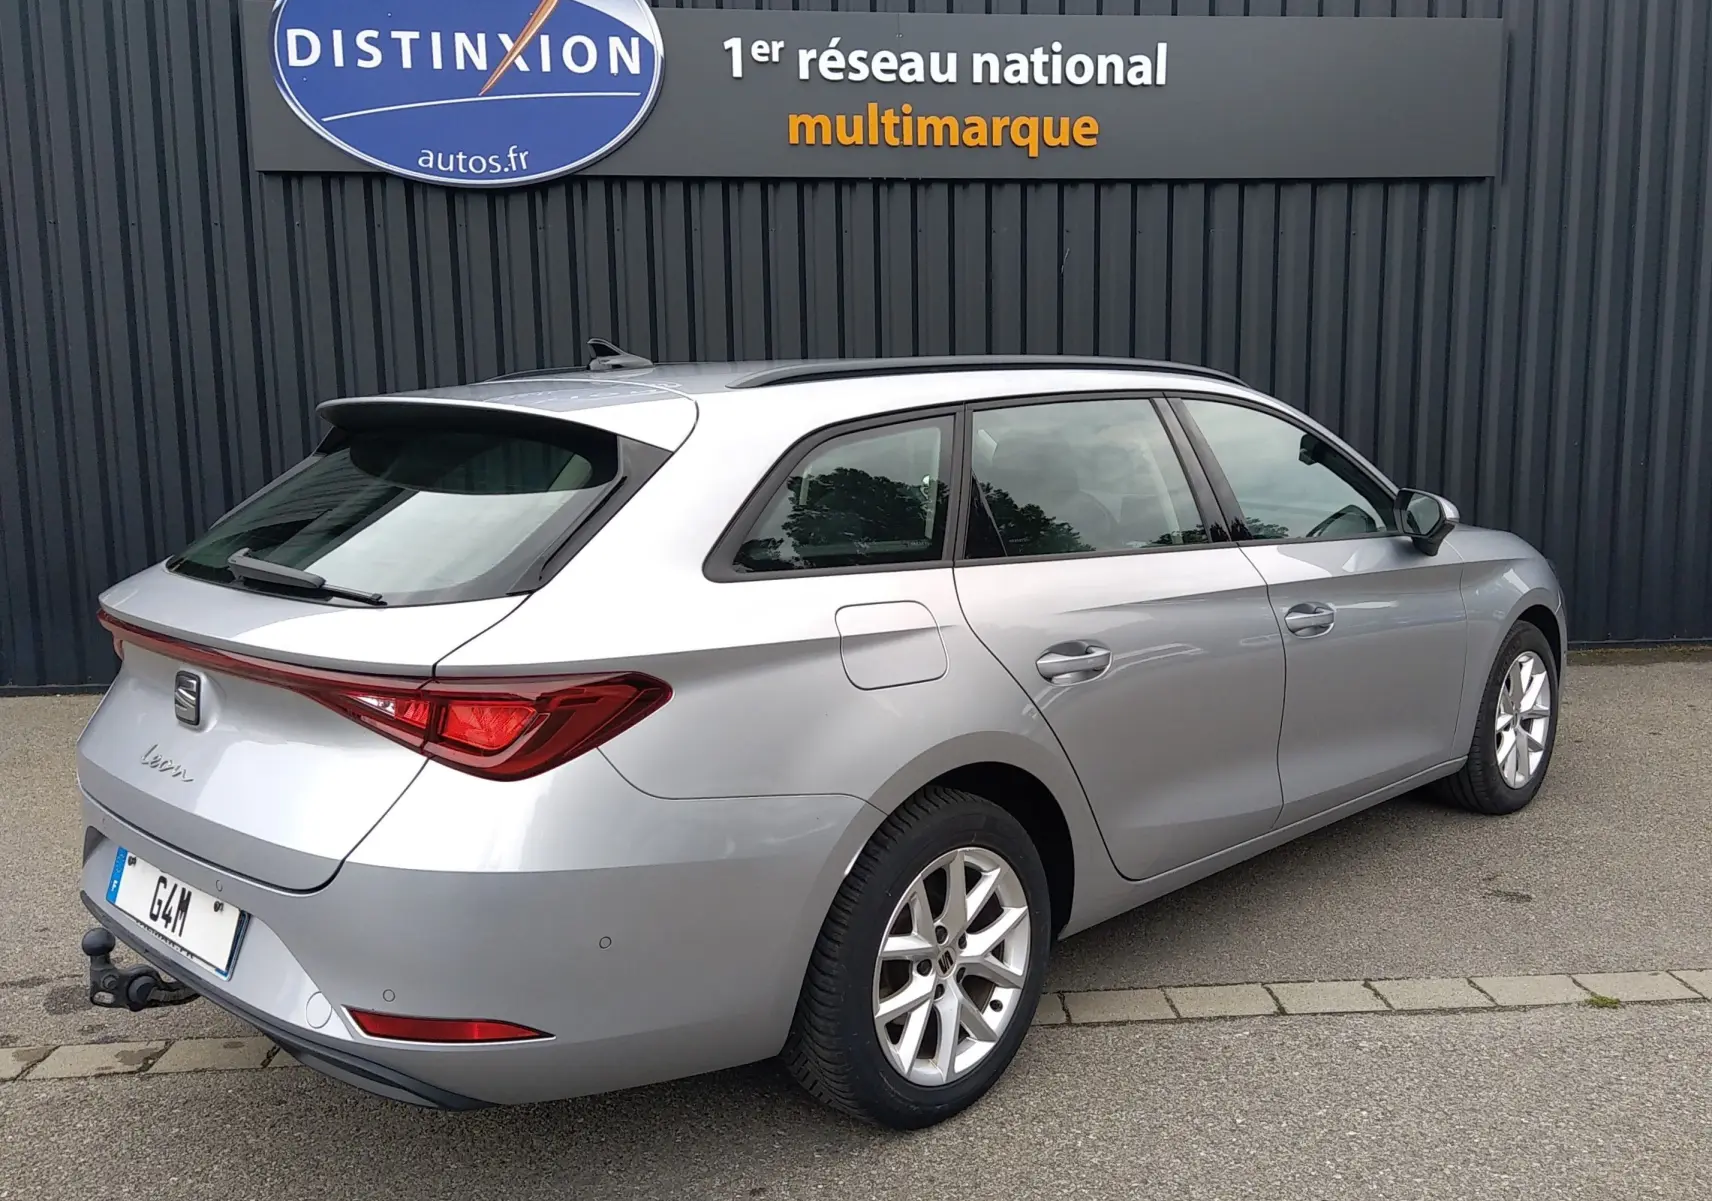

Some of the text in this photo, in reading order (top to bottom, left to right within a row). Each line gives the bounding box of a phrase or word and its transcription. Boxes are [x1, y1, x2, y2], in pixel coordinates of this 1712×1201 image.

[286, 28, 642, 75] DISTINXION
[723, 36, 1168, 86] 1er réseau national
[788, 102, 1100, 158] multimarque
[417, 145, 530, 174] autos.fr
[149, 875, 192, 937] G4M
